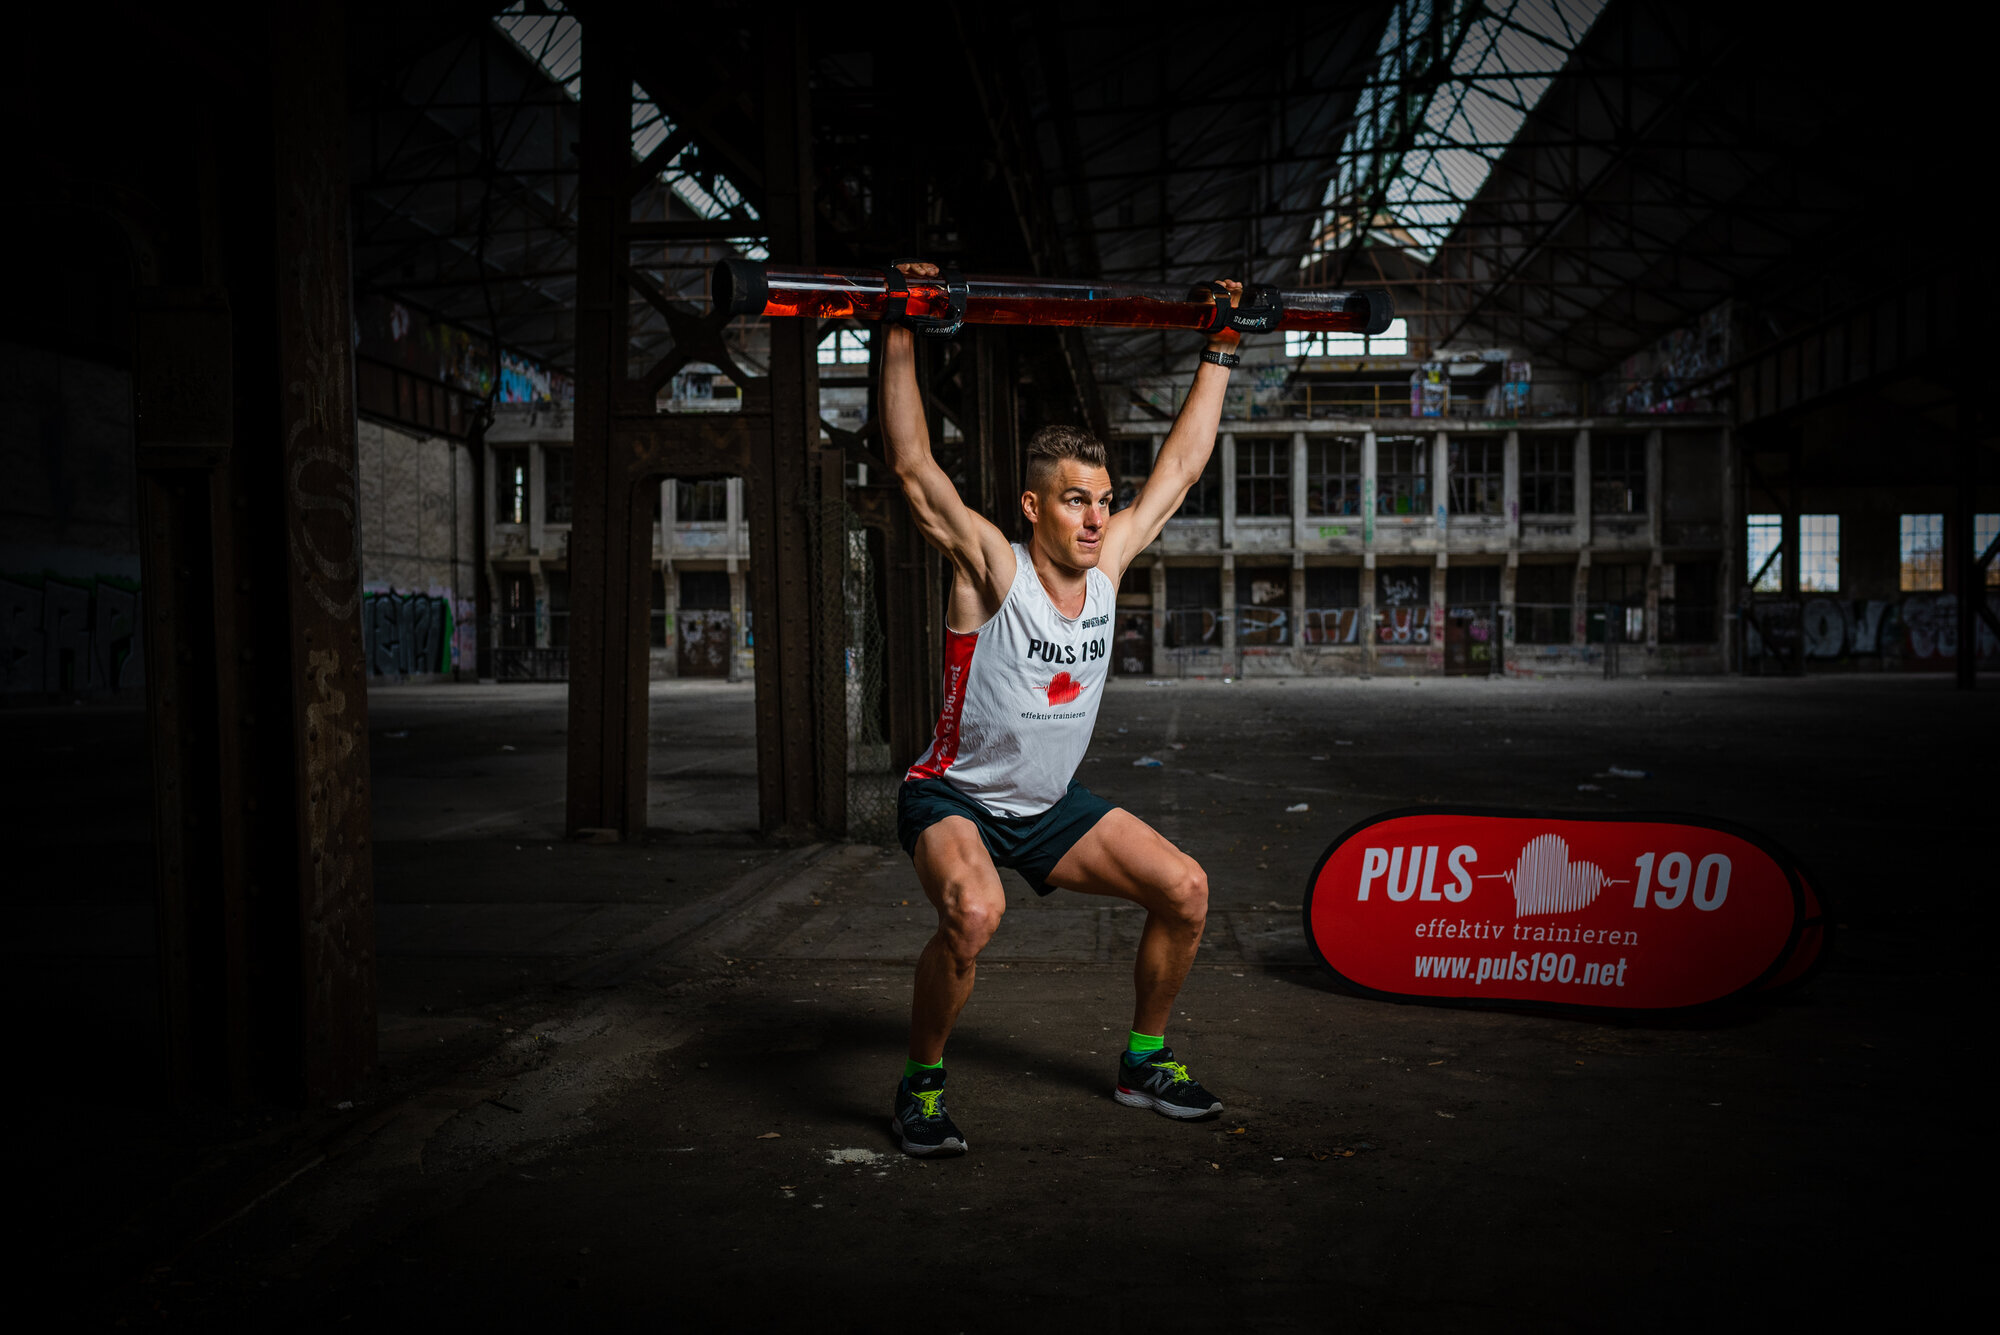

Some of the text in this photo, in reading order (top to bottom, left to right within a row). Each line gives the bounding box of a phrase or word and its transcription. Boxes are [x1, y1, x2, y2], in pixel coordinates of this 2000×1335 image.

[1027, 637, 1106, 665] PULS 190
[1021, 711, 1086, 720] effektiv trainieren
[1357, 845, 1732, 911] PULS 190
[1415, 919, 1638, 946] effektiv trainieren
[1415, 951, 1627, 987] www.puls190.net
